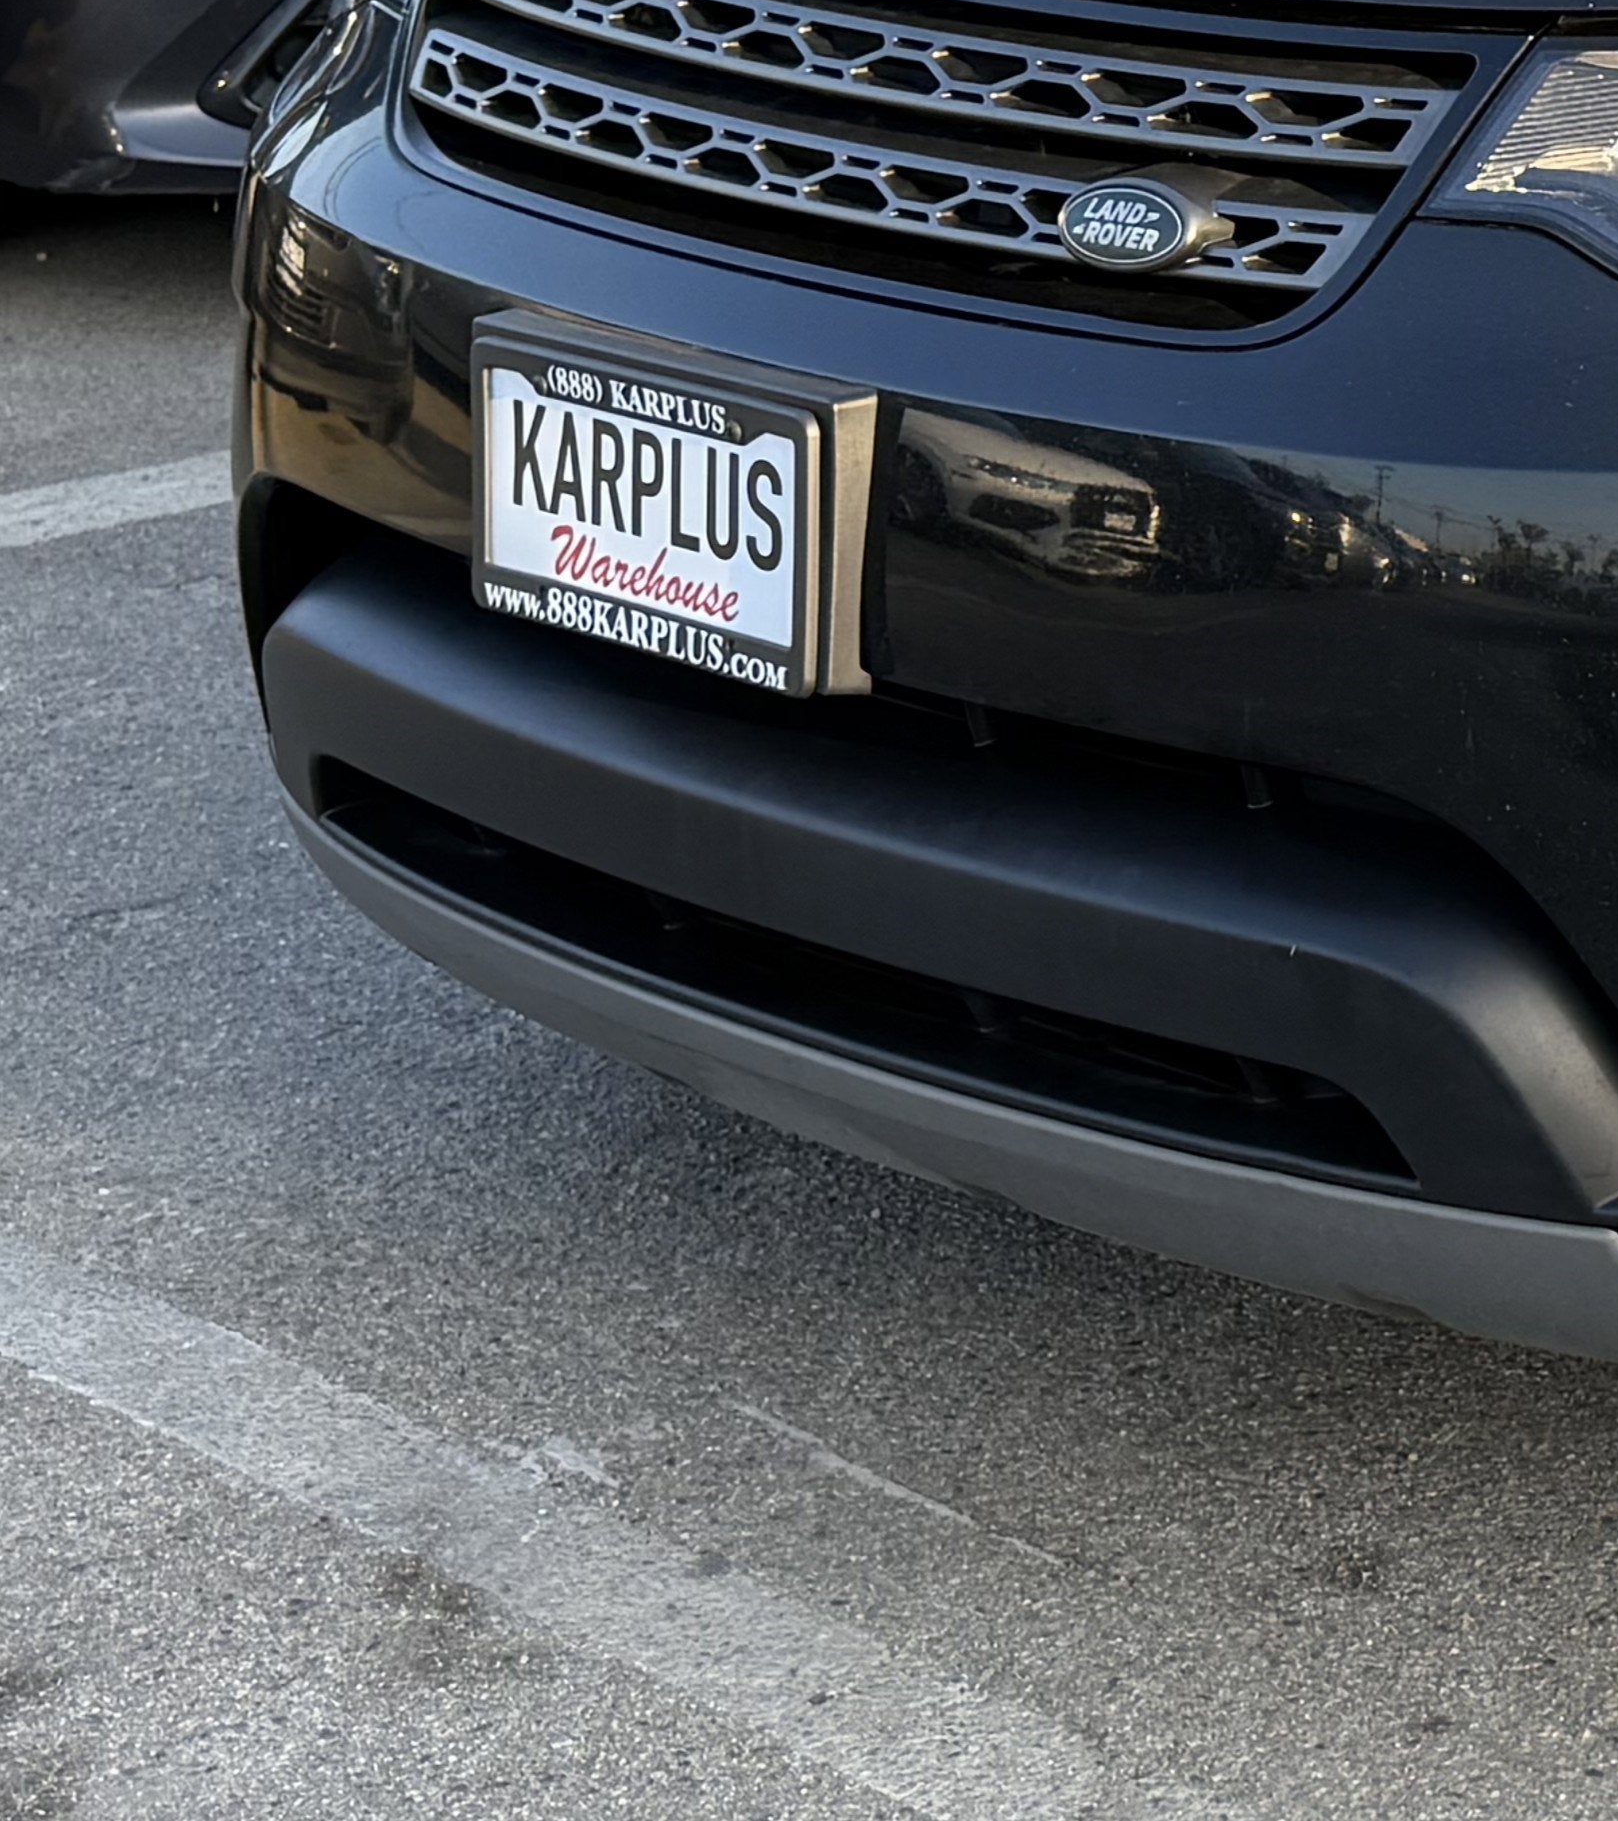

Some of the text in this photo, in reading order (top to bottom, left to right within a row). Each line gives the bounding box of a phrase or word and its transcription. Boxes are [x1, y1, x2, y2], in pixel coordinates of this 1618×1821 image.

[1082, 223, 1160, 251] ROVER
[1084, 197, 1147, 224] LAND
[546, 364, 727, 435] (888) KARPLUS
[512, 399, 783, 572] KARPLUS
[550, 525, 739, 622] Warehouse
